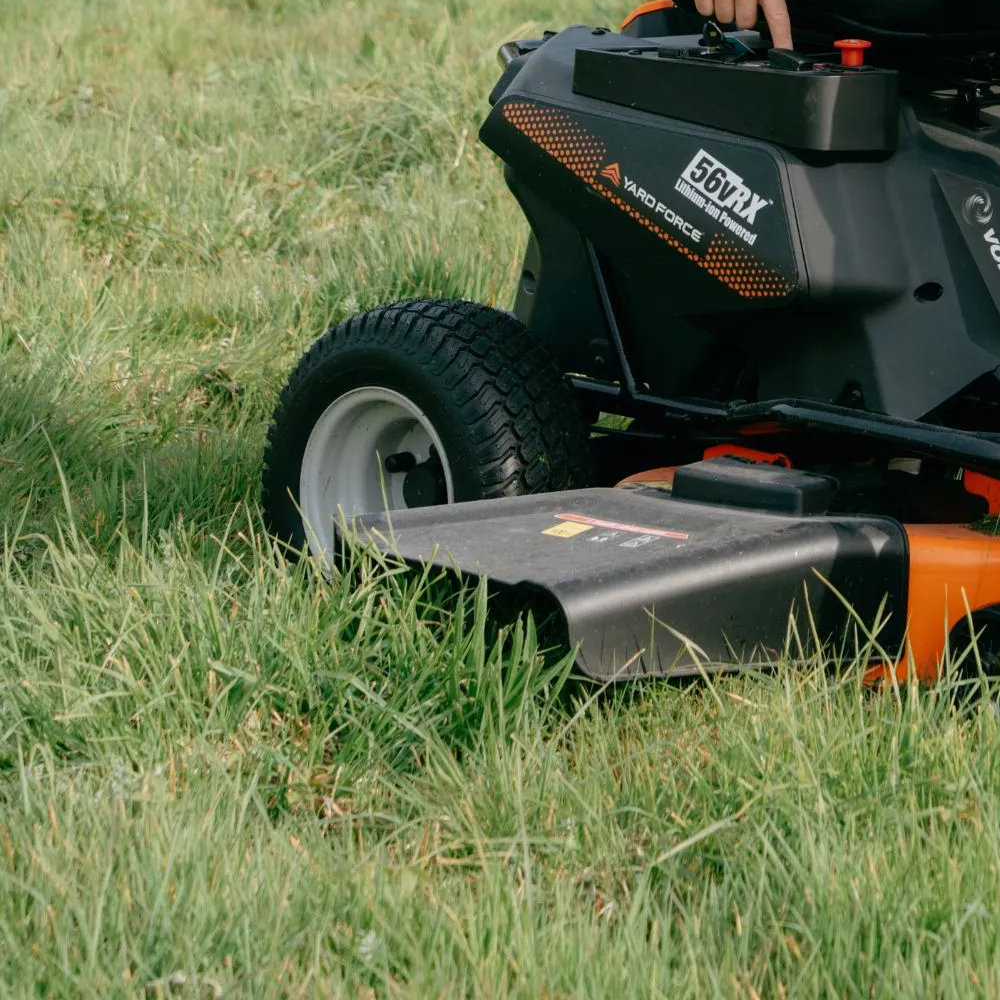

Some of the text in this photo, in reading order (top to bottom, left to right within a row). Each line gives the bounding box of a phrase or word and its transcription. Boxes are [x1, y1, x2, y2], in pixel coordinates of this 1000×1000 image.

[624, 176, 702, 242] YARD FORCE
[719, 211, 757, 246] Powered
